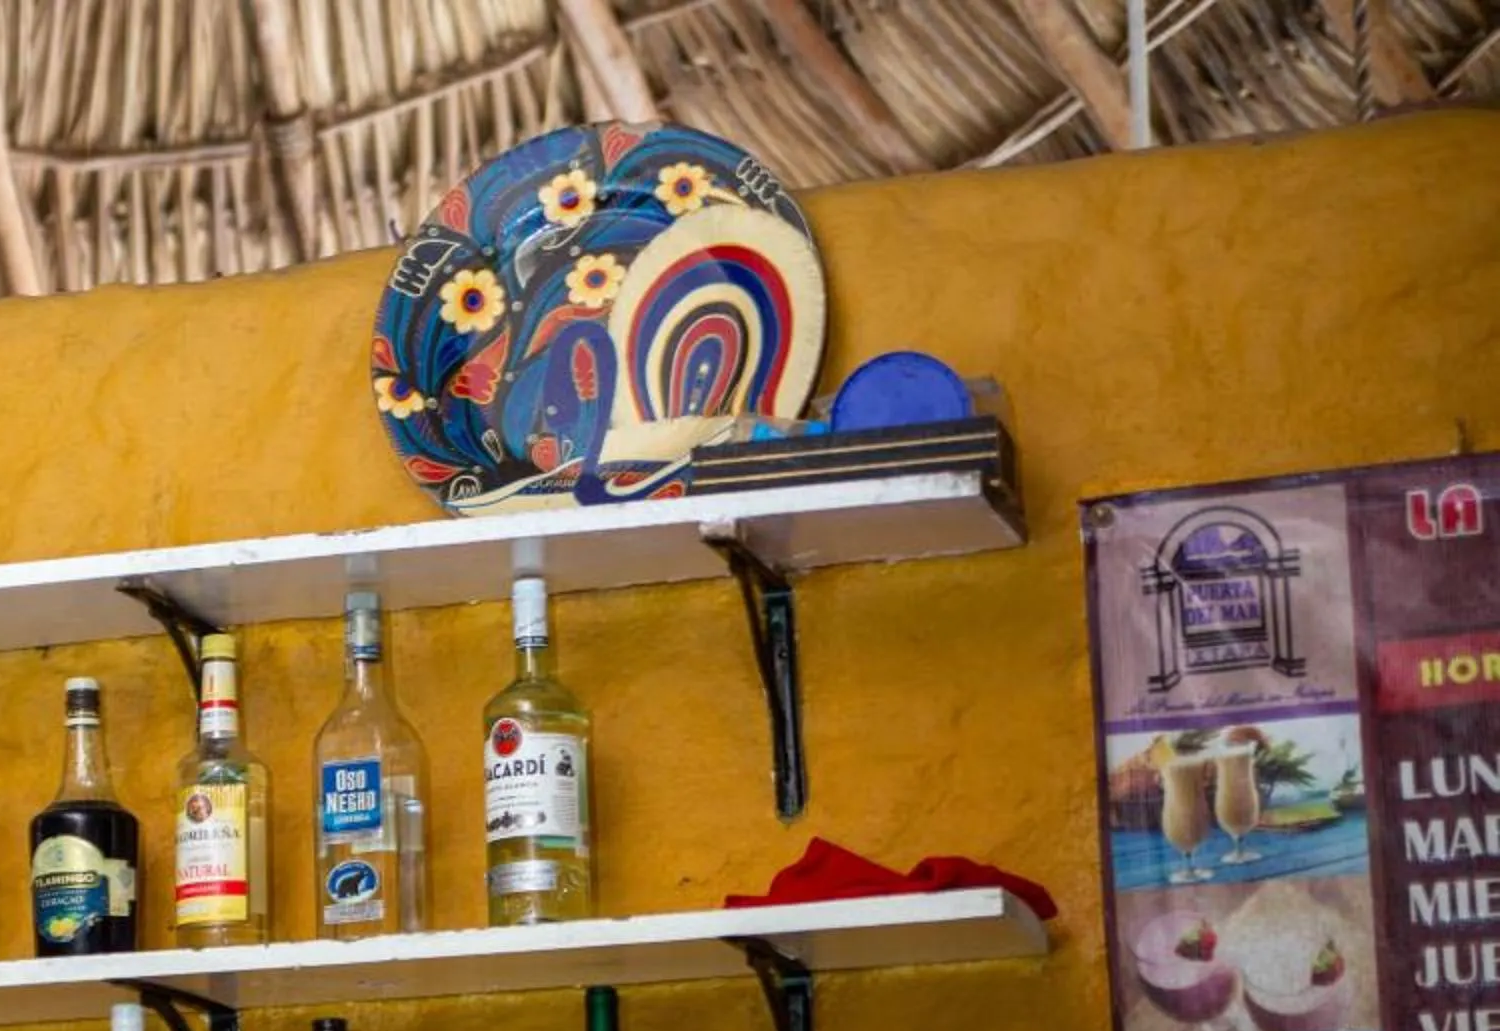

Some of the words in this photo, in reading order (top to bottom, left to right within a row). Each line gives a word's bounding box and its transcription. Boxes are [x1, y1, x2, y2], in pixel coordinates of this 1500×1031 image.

[1406, 484, 1483, 540] LA
[1221, 602, 1260, 622] MAR
[335, 769, 366, 793] OSO
[484, 752, 546, 782] ACARDÍ
[1400, 753, 1500, 800] LUN
[325, 790, 377, 814] NEGRO
[1409, 878, 1500, 926] MIE
